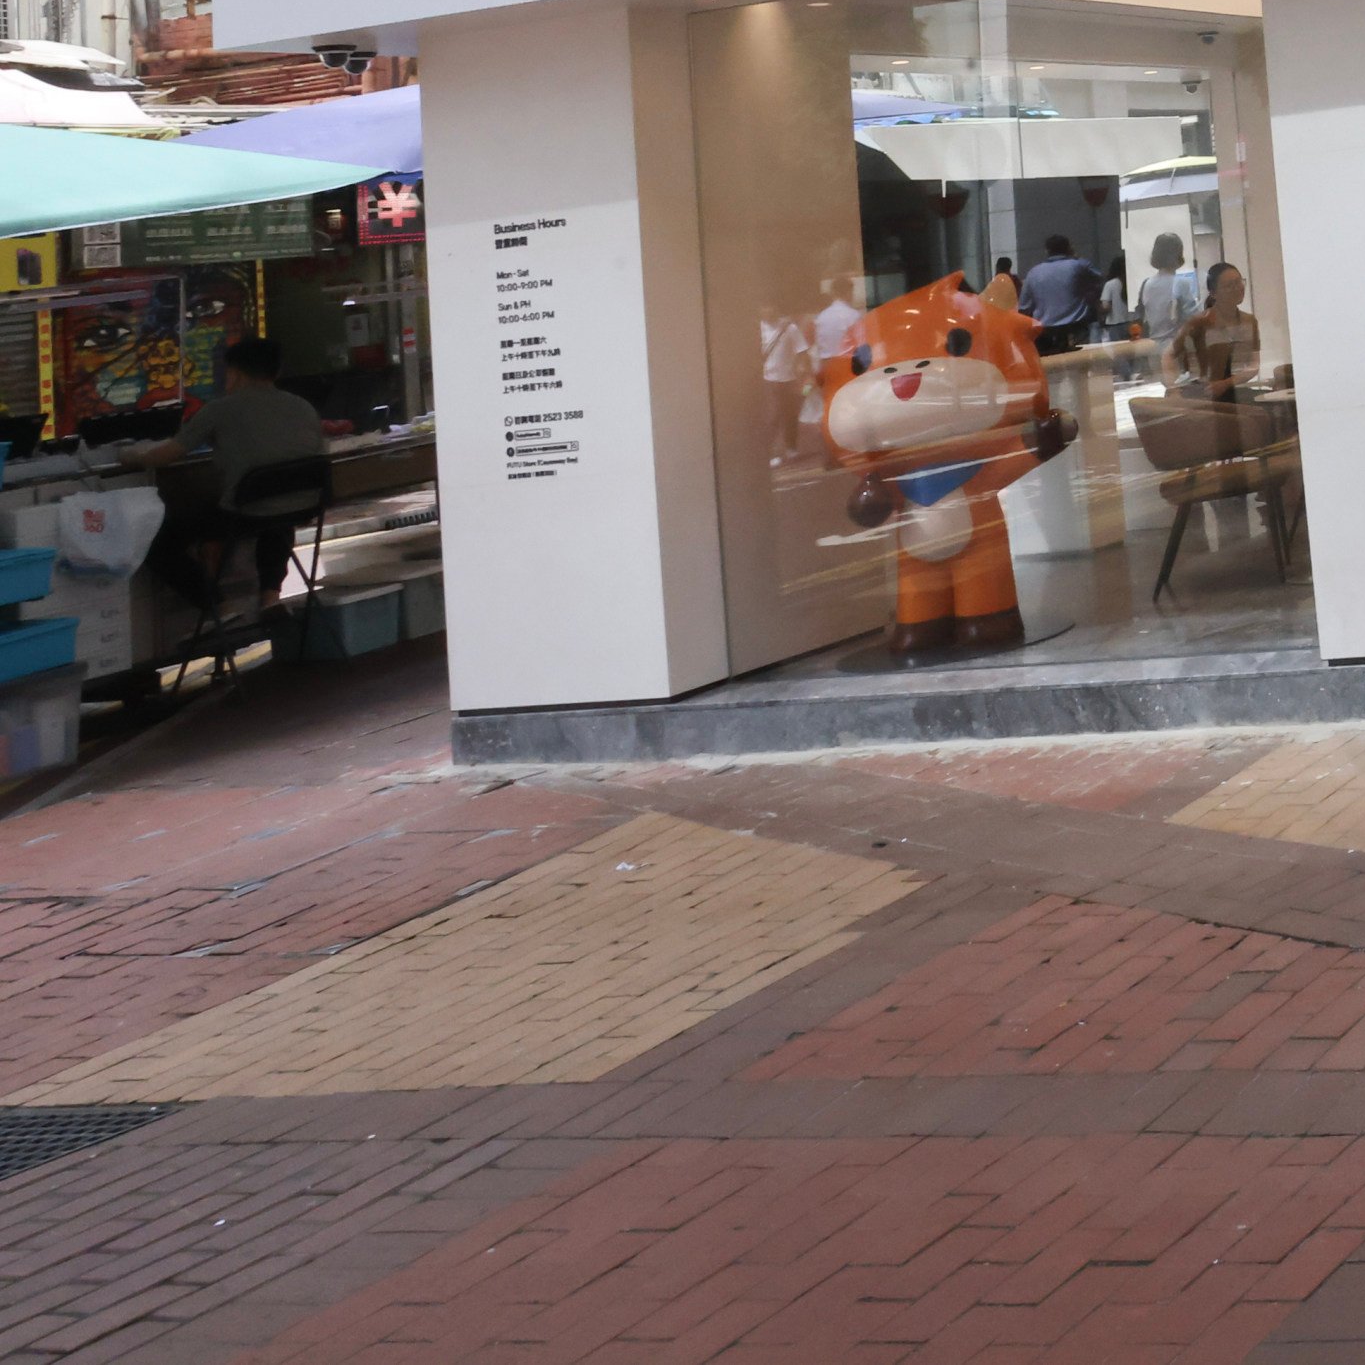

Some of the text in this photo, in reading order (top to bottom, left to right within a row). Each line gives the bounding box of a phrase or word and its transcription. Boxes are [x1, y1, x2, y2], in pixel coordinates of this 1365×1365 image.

[494, 217, 567, 234] Business Hours
[540, 279, 553, 289] PM
[498, 302, 513, 312] Sun
[542, 311, 555, 321] PM
